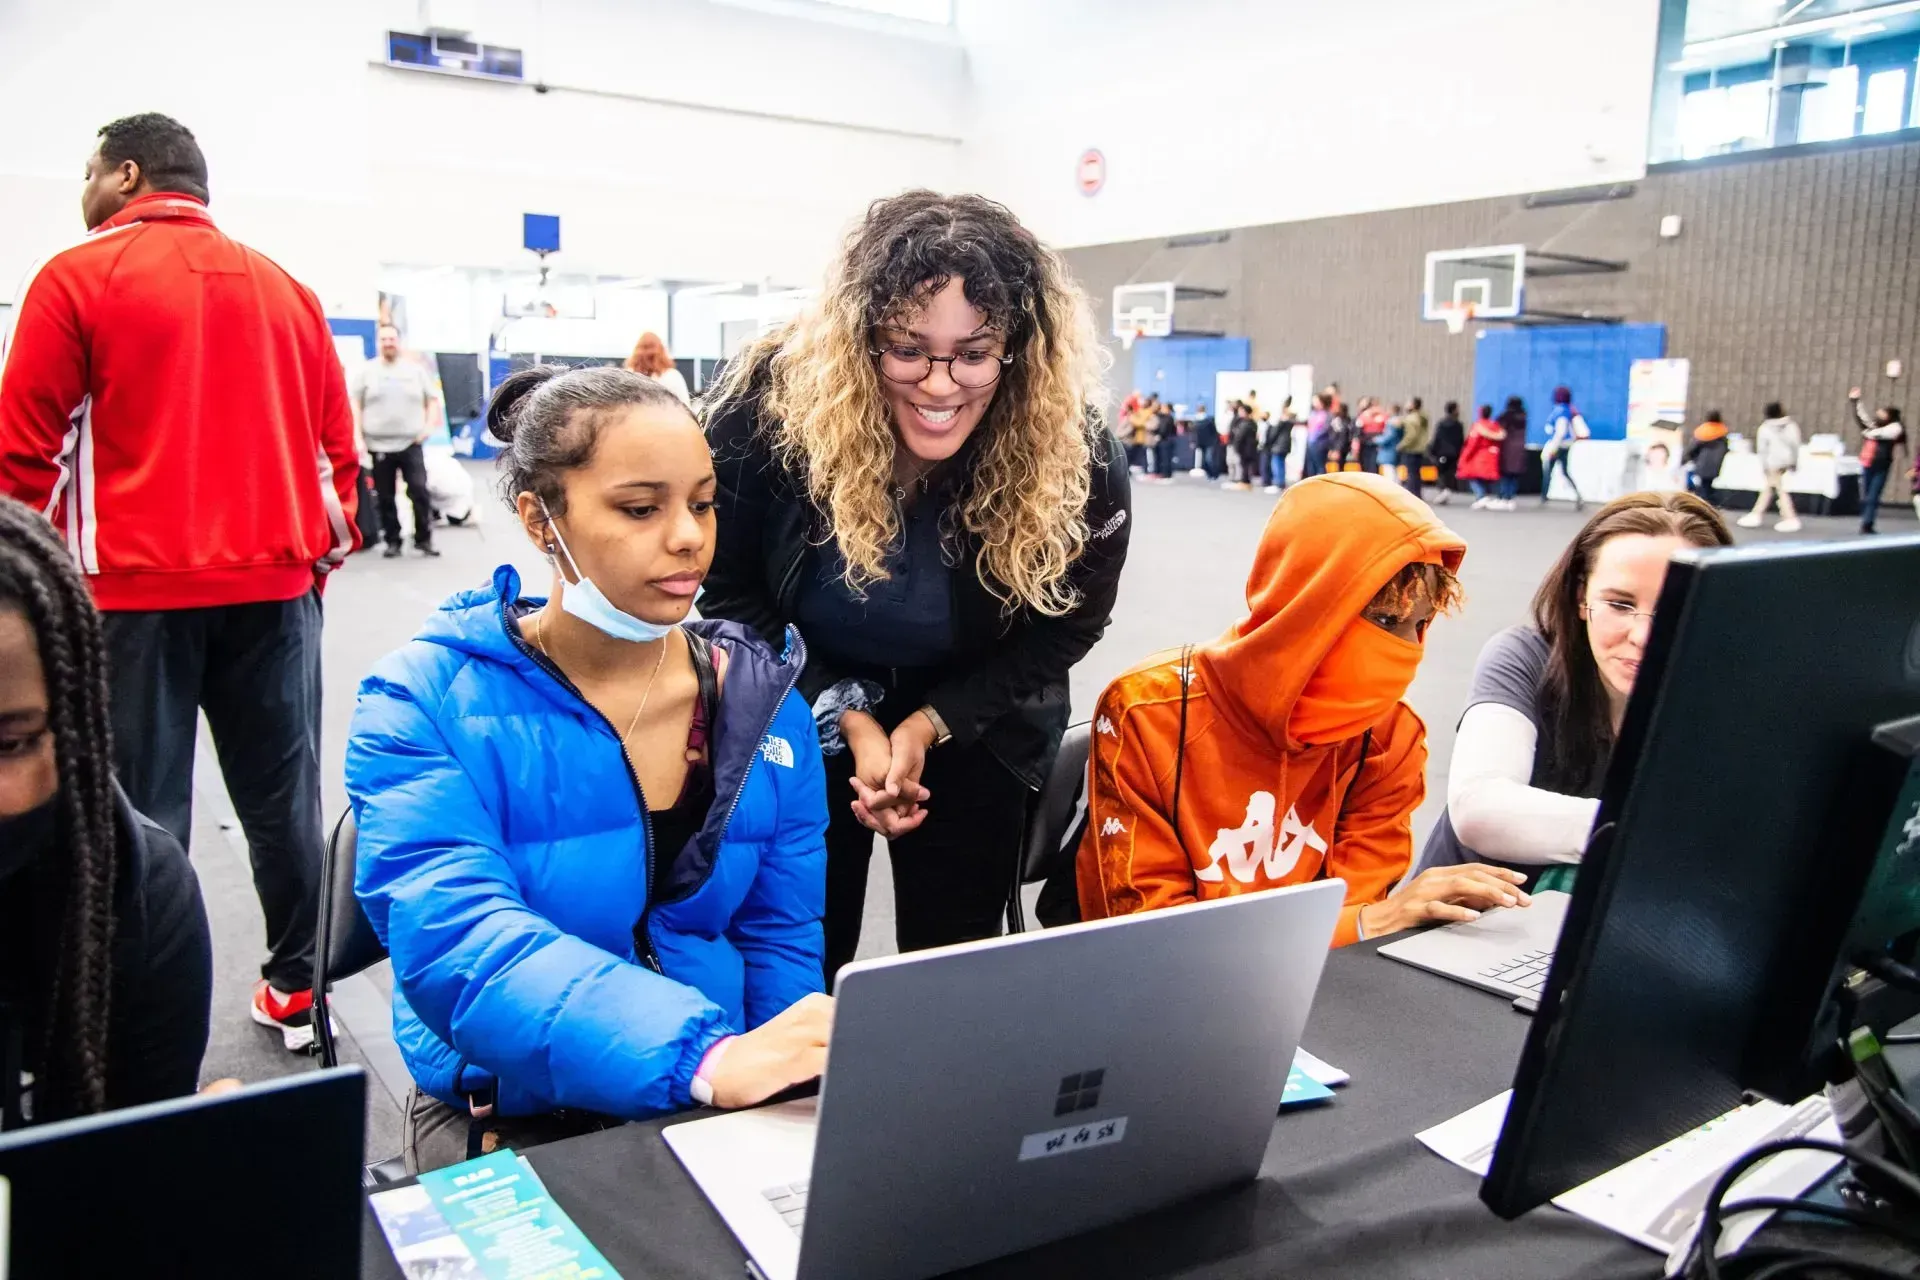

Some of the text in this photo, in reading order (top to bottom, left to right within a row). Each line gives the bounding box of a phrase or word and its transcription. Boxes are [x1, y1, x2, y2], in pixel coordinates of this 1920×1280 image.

[766, 735, 782, 746] THE
[759, 742, 782, 755] ORTH
[764, 751, 783, 765] FACE
